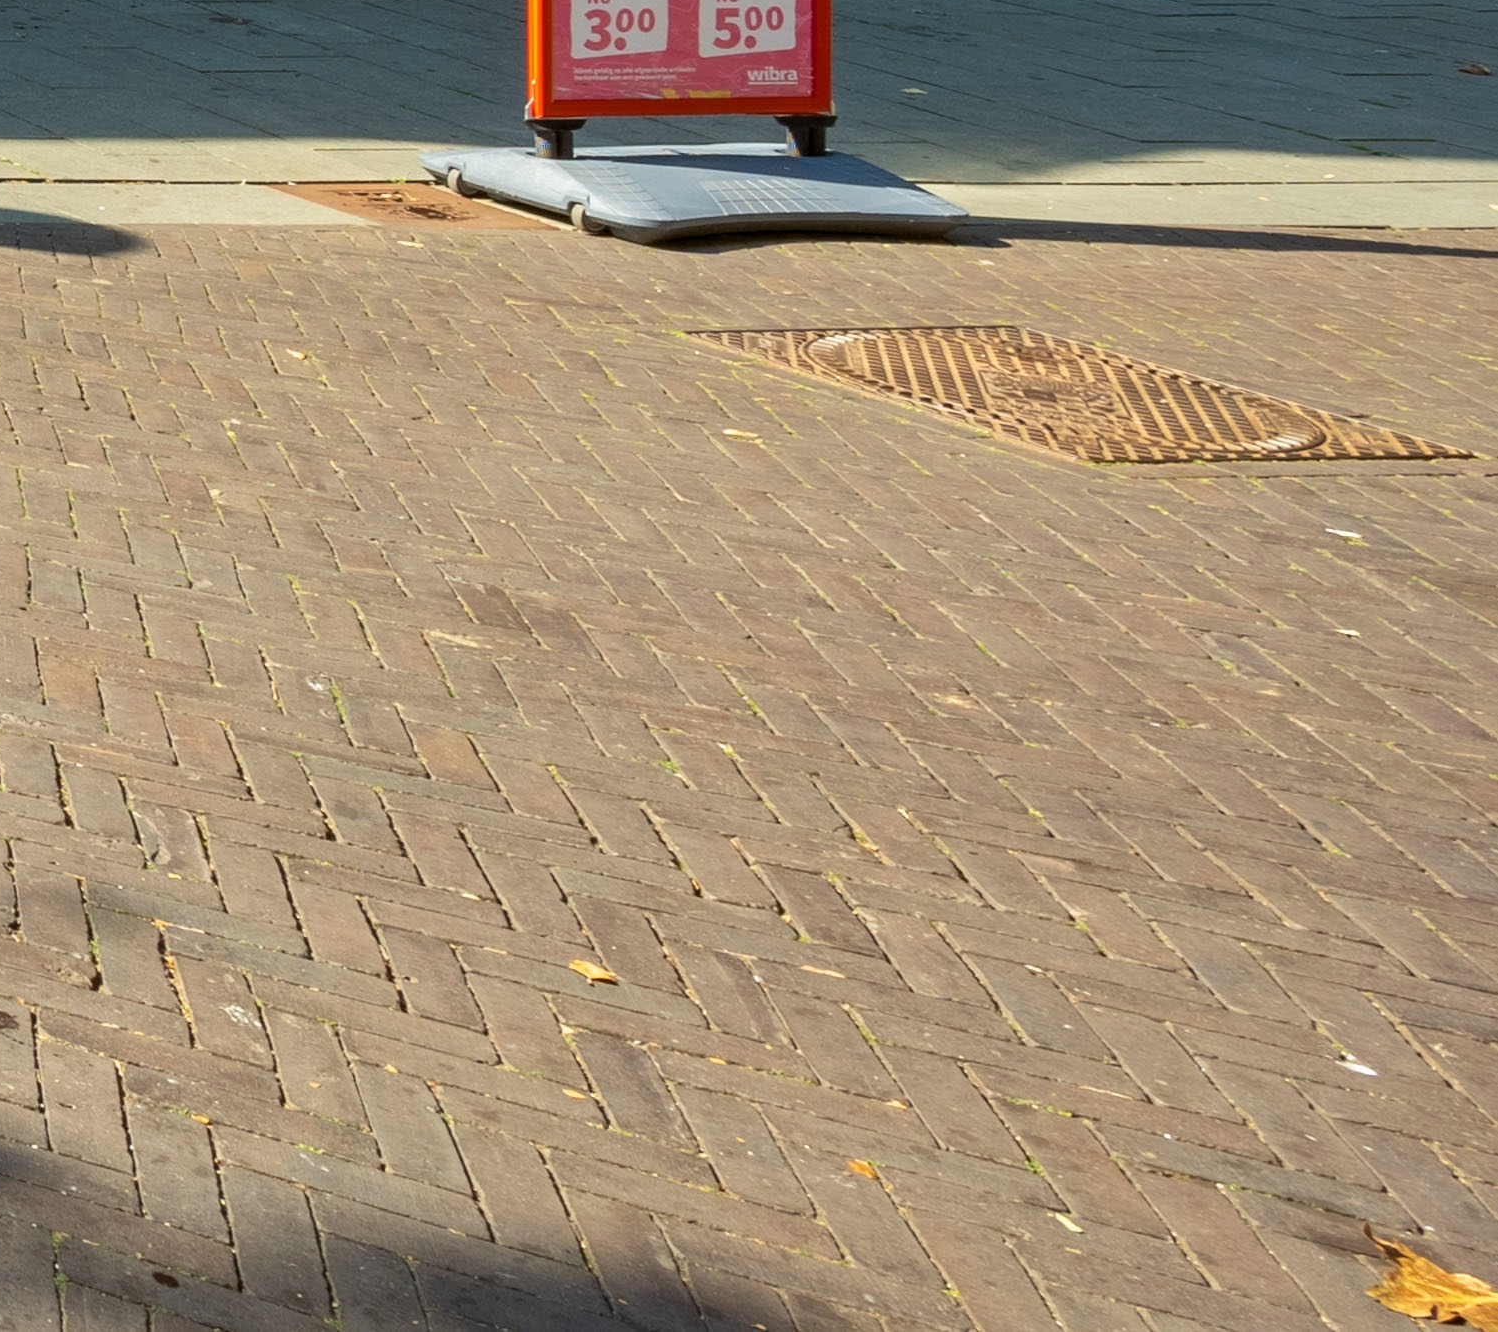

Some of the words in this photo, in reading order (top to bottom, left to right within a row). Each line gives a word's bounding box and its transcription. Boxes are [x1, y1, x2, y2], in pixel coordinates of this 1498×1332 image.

[583, 8, 656, 51] 3.00
[713, 6, 784, 50] 5.00
[747, 66, 798, 82] wibra
